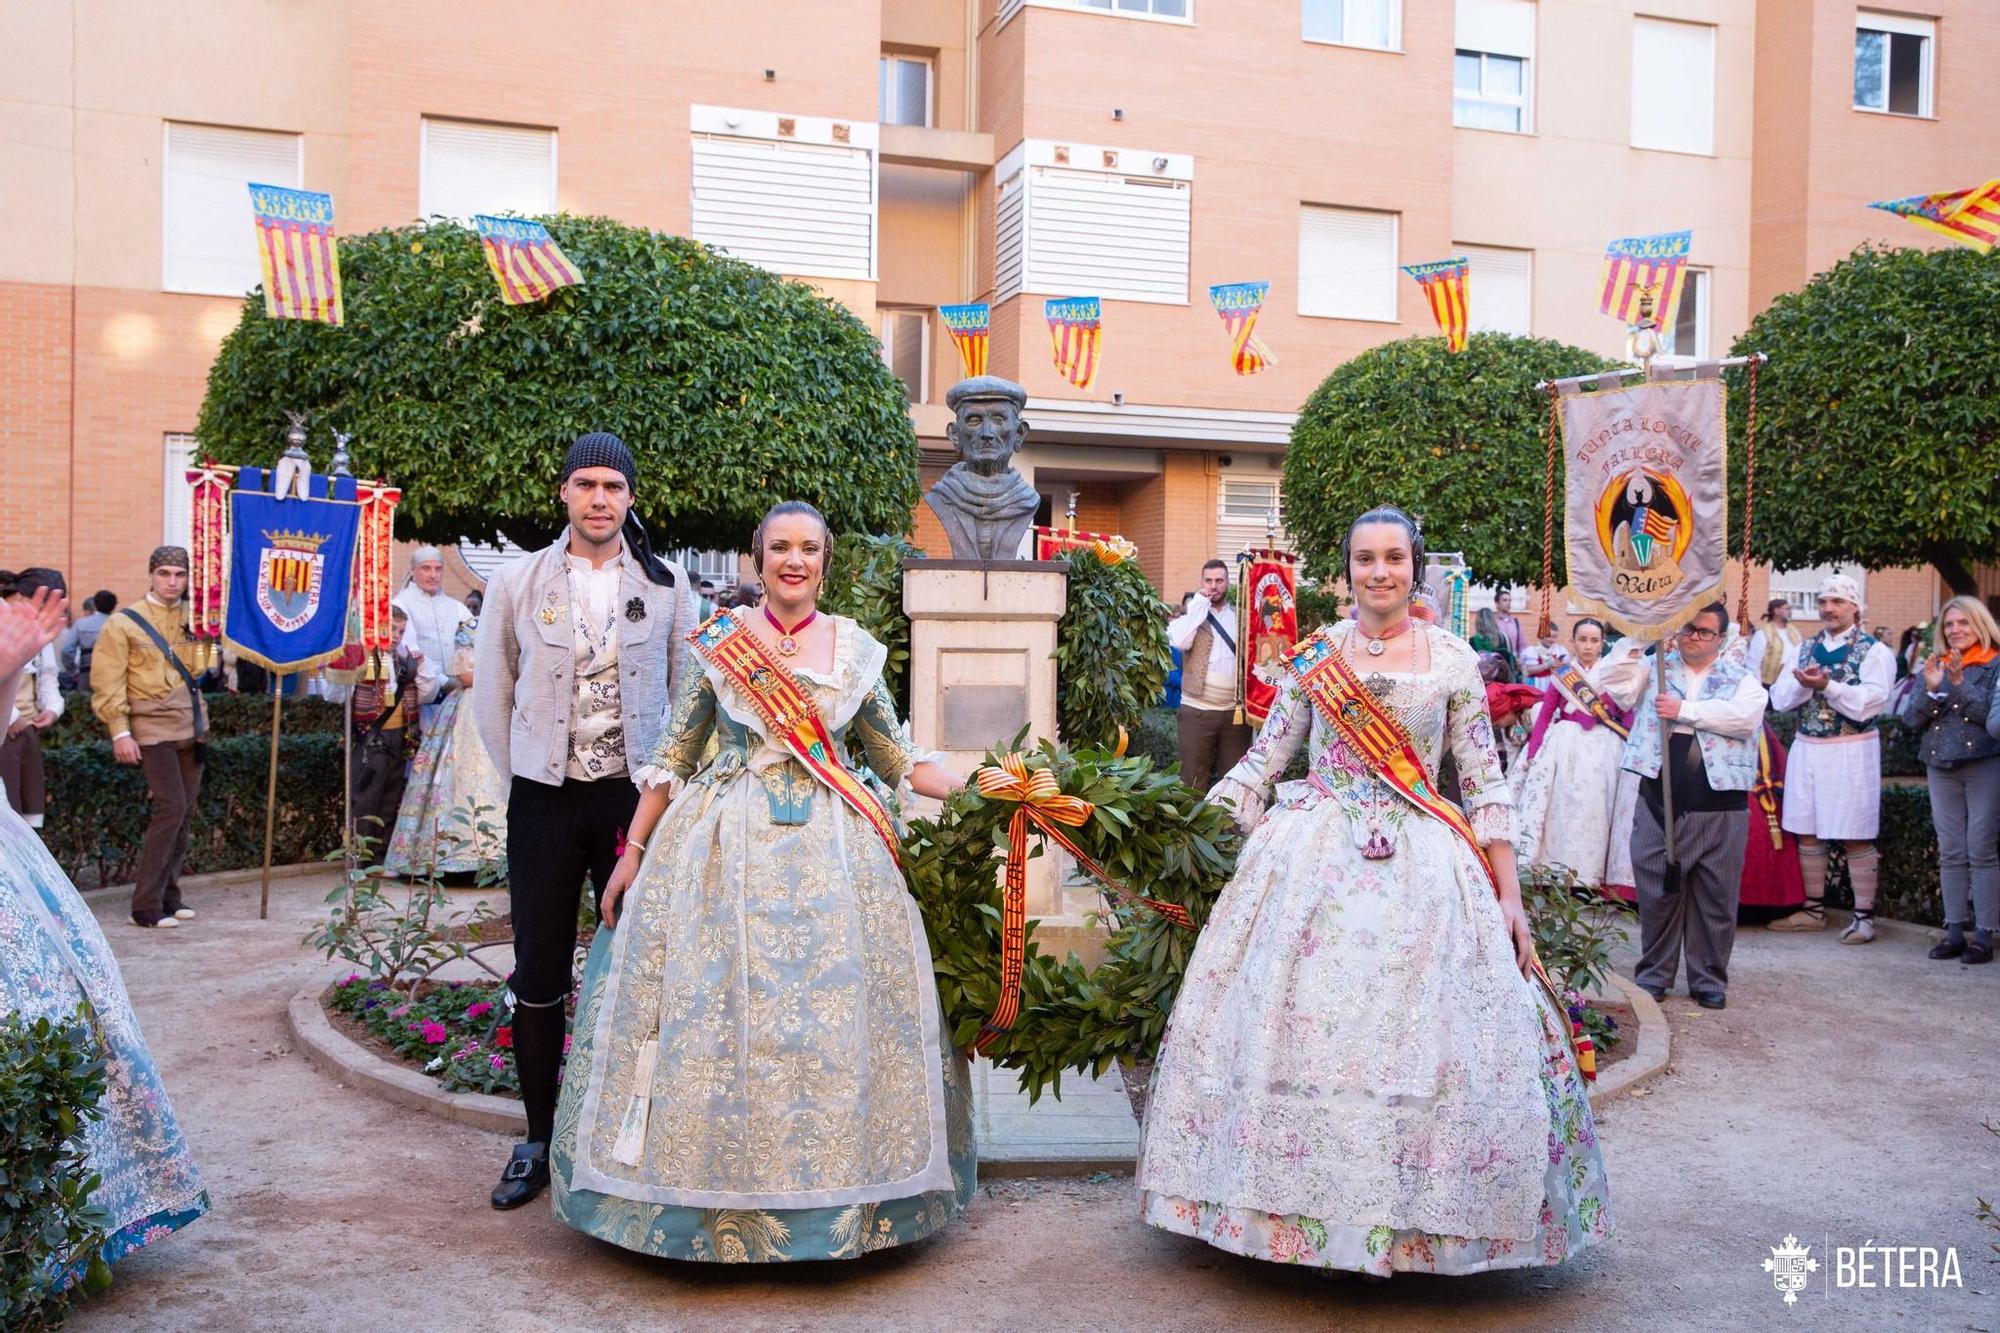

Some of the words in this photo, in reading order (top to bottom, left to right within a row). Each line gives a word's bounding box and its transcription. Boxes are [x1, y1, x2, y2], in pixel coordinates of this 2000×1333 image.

[1576, 418, 1633, 465] JUNTA
[1640, 417, 1703, 453] LOCAL
[1601, 446, 1684, 478] FALLERA
[268, 550, 318, 561] FALLA
[1007, 858, 1023, 914] LOCAL
